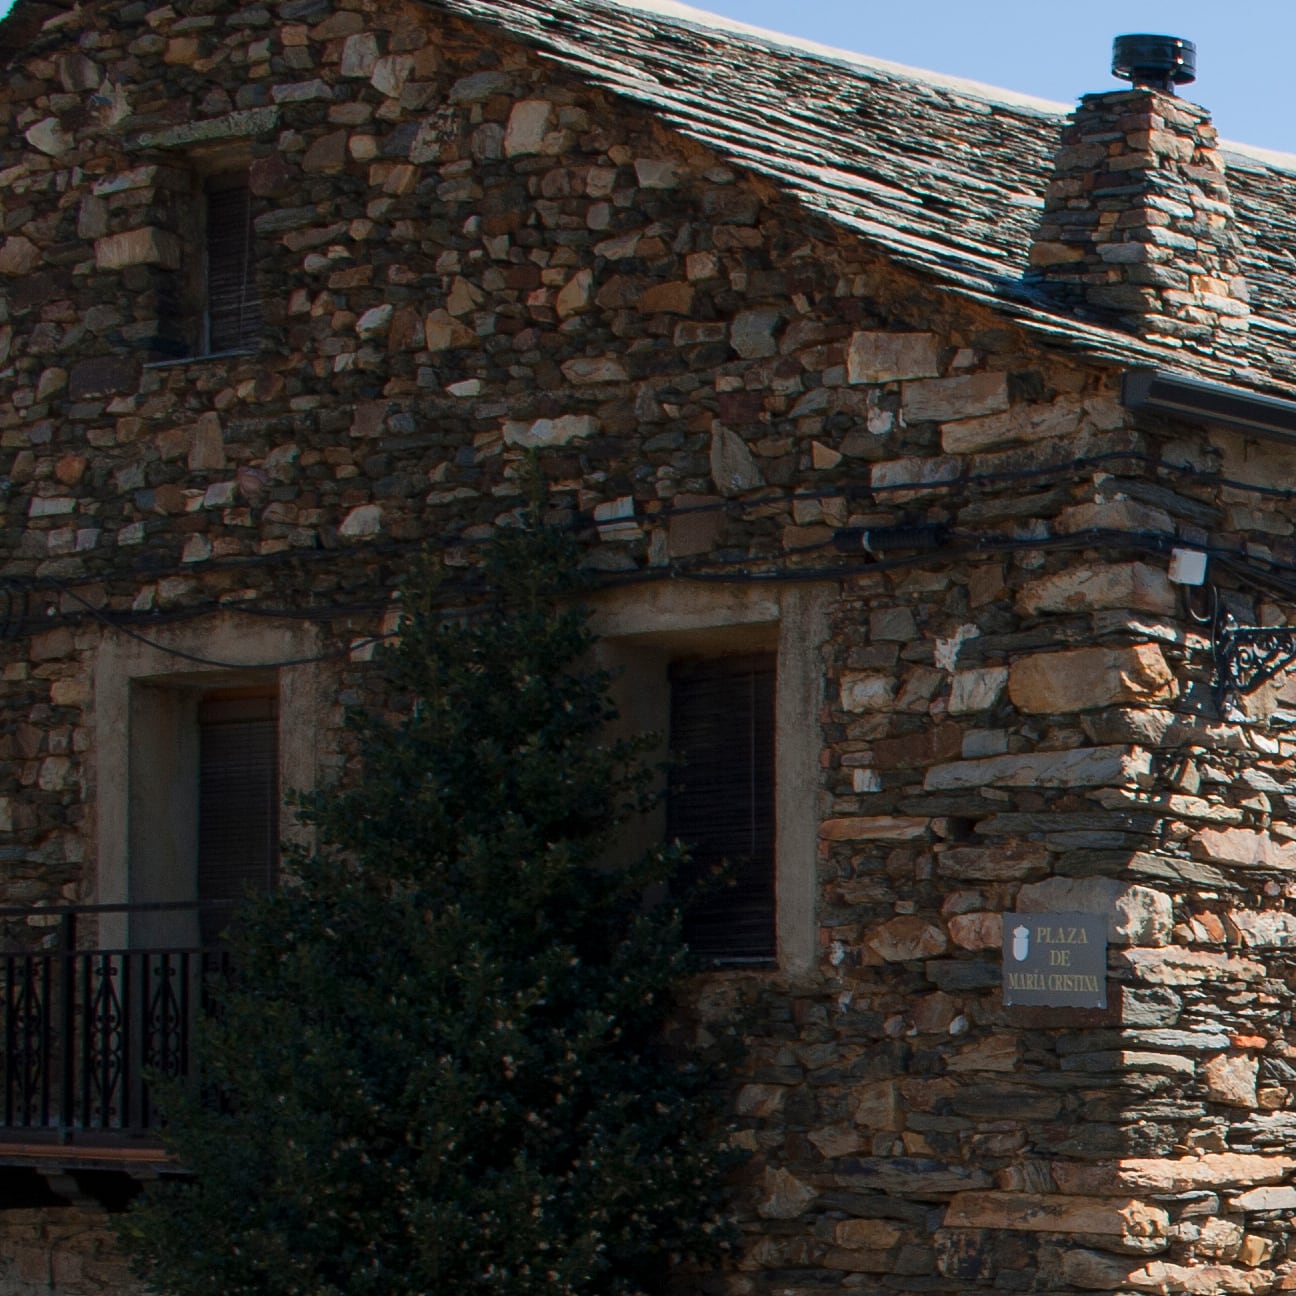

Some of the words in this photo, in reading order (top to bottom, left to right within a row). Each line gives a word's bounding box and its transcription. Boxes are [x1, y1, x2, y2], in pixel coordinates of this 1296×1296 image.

[1036, 927, 1088, 944] PLAZA
[1050, 950, 1071, 967] DE
[1048, 974, 1099, 992] CRISTINA
